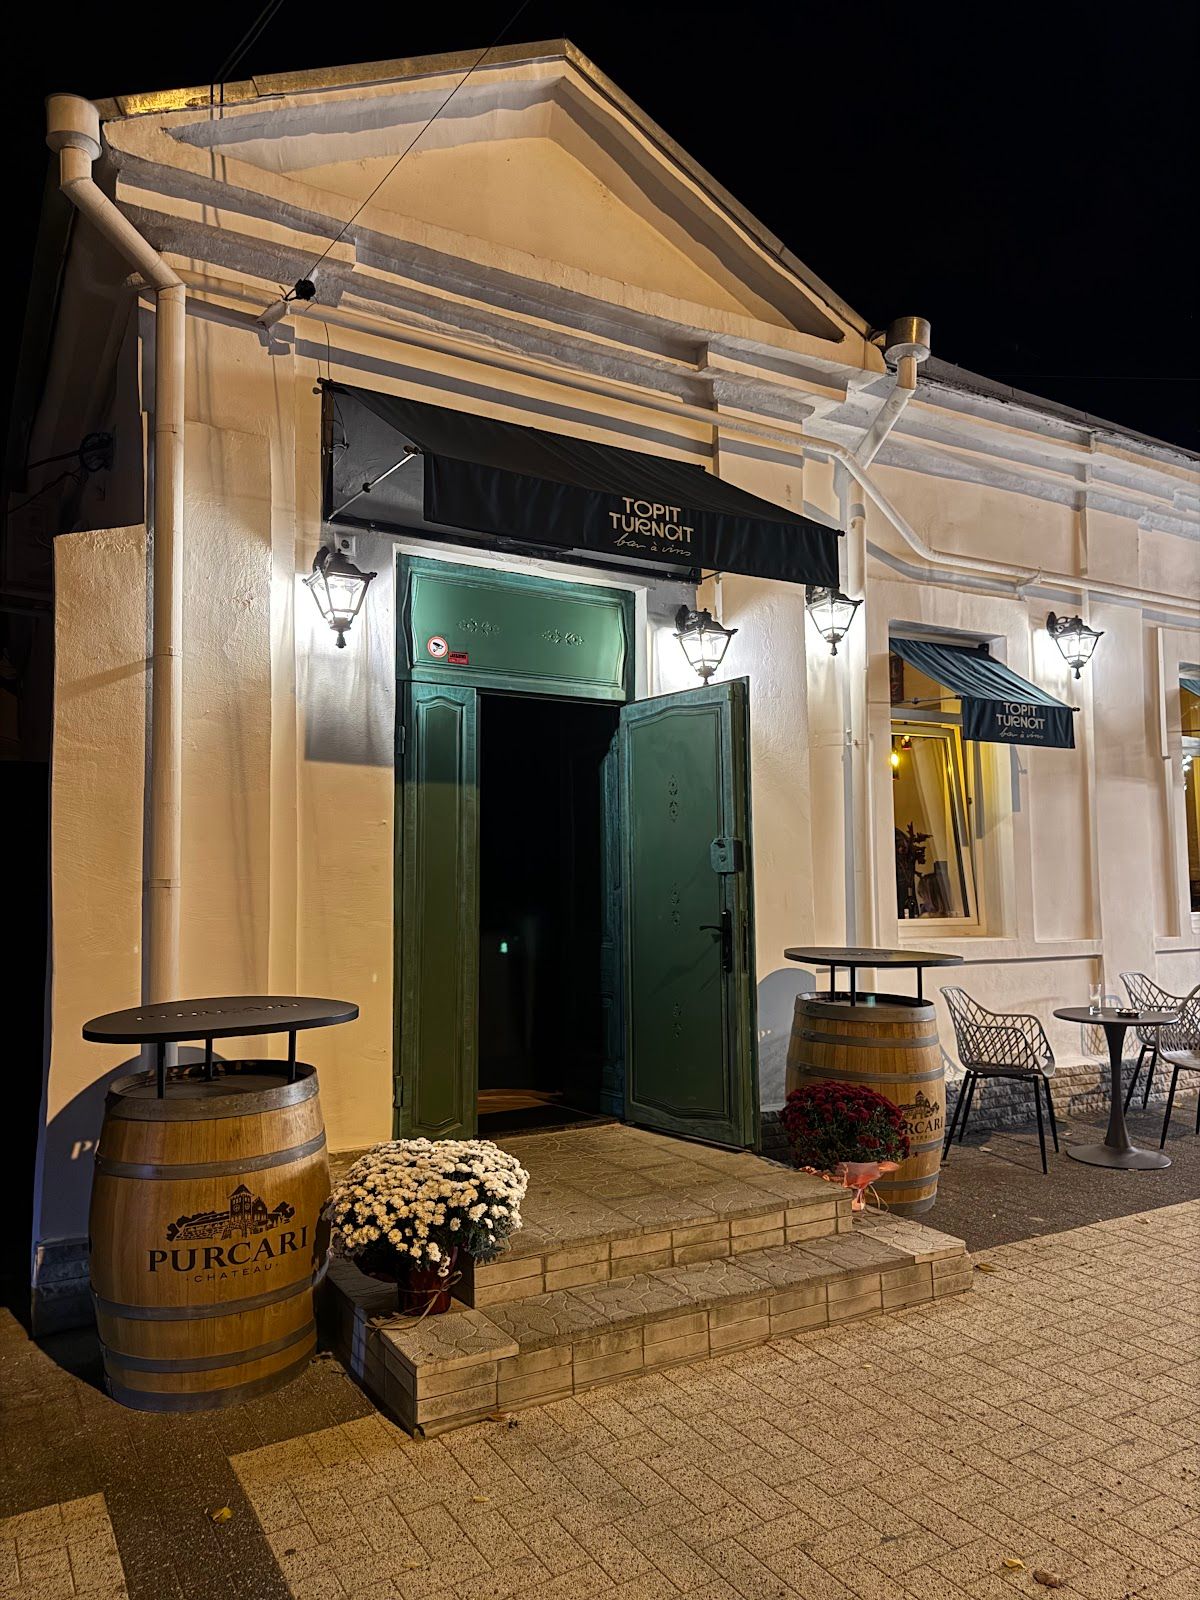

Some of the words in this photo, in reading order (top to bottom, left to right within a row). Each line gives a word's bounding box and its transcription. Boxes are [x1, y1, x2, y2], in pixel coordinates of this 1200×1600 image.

[622, 496, 682, 523] TOPIT
[613, 532, 647, 549] bar
[650, 541, 658, 552] à
[1002, 702, 1038, 717] TOPIT
[903, 1116, 943, 1135] RCARI
[147, 1225, 309, 1273] PURCARI
[193, 1262, 273, 1283] CHATEAU
